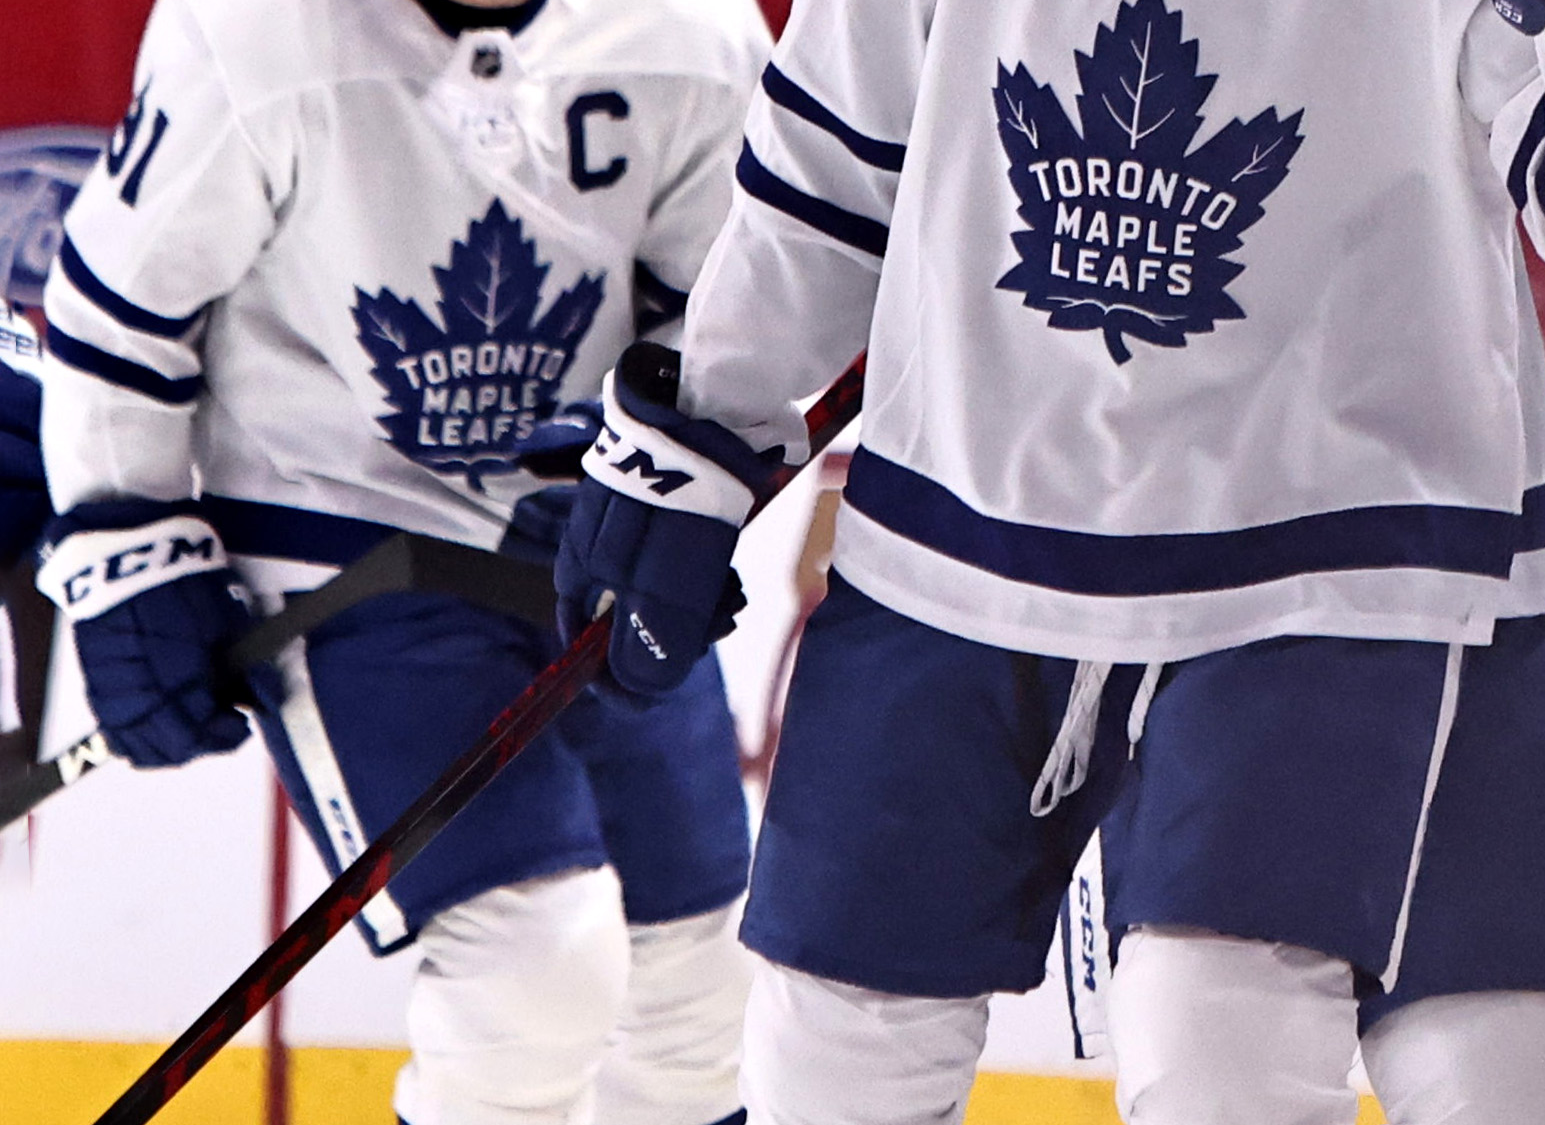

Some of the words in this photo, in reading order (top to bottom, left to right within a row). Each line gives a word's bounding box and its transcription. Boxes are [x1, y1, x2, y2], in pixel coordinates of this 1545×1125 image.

[566, 90, 630, 193] C
[1028, 157, 1237, 231] TORONTO
[1054, 202, 1198, 257] MAPLE
[1050, 242, 1193, 297] LEAFS
[397, 342, 566, 389] TORONTO
[421, 379, 541, 415] MAPLE
[417, 412, 535, 446] LEAFS
[63, 537, 214, 605] CCM
[630, 611, 668, 661] CCM
[1079, 876, 1097, 993] CCM
